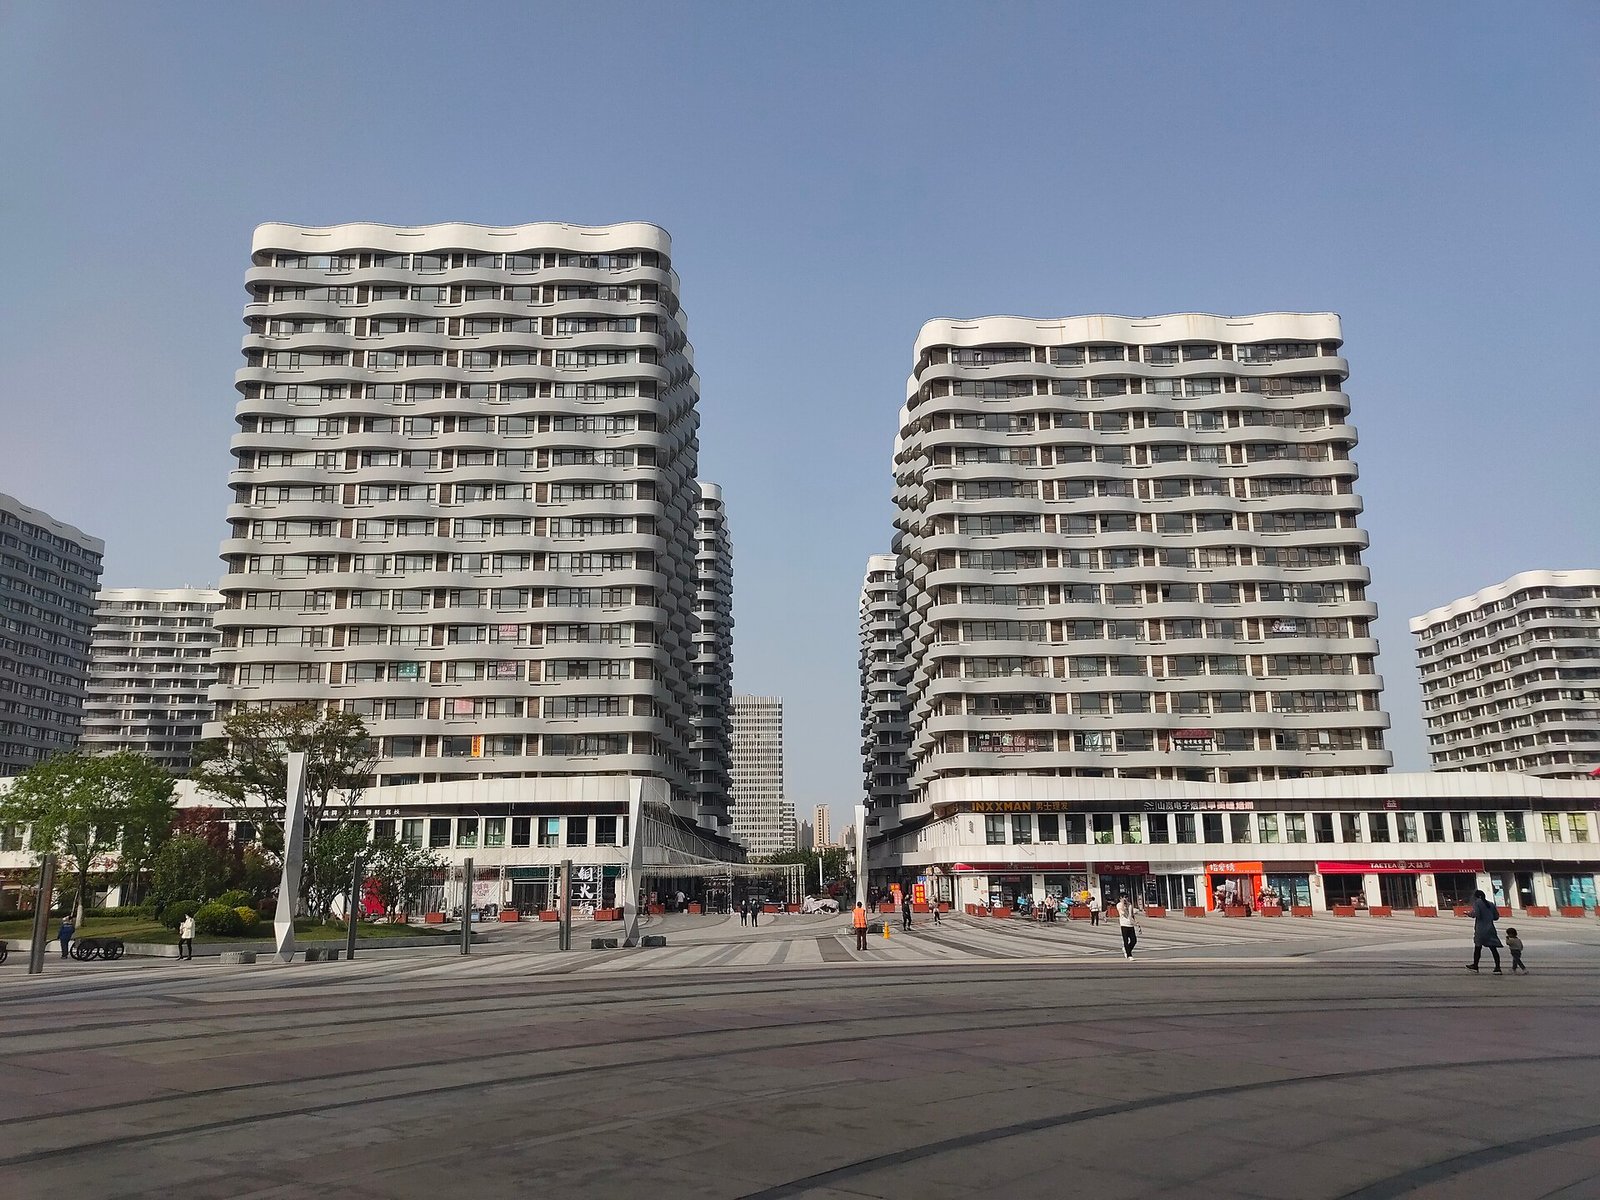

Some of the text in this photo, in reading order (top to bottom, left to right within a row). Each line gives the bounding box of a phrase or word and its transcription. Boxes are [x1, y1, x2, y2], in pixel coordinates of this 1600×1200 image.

[971, 802, 1069, 811] INXXMAN 男士理发
